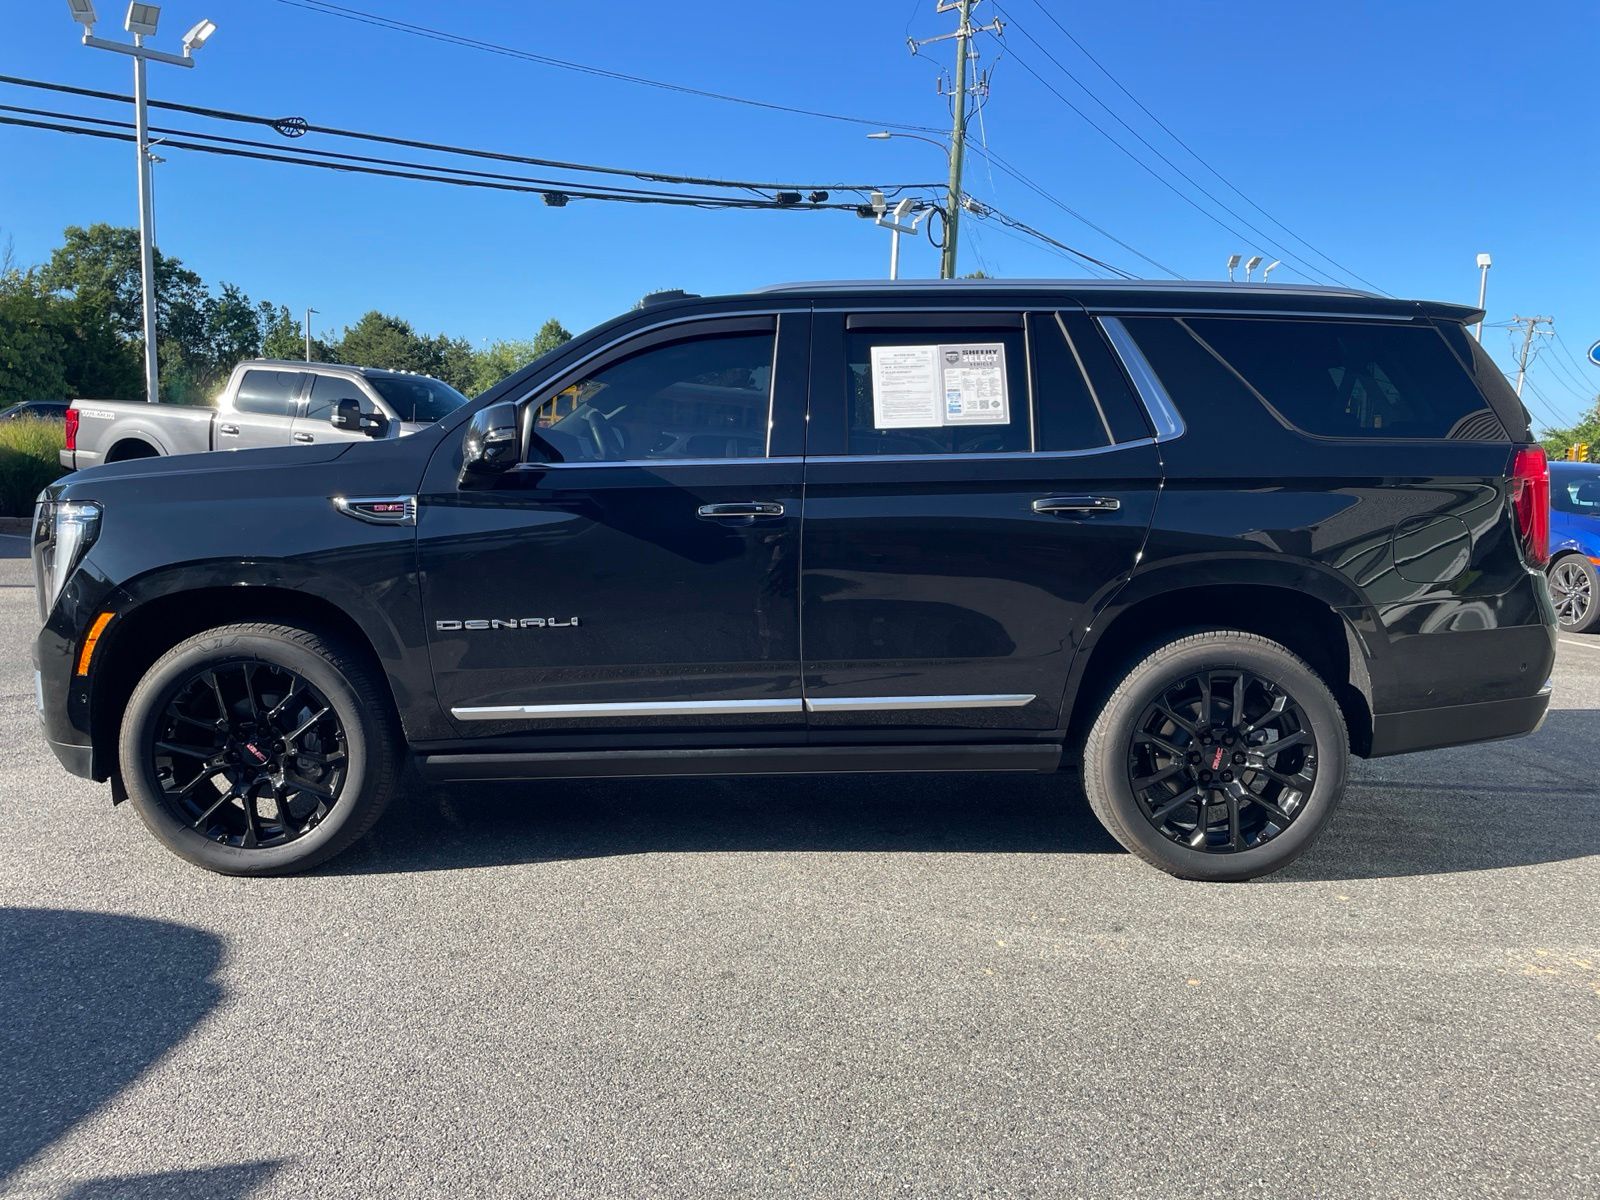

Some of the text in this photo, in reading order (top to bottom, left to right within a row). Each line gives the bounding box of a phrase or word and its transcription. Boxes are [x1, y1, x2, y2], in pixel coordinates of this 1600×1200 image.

[962, 354, 999, 362] SELECT
[436, 616, 579, 630] DENALI
[1212, 747, 1224, 770] GMC
